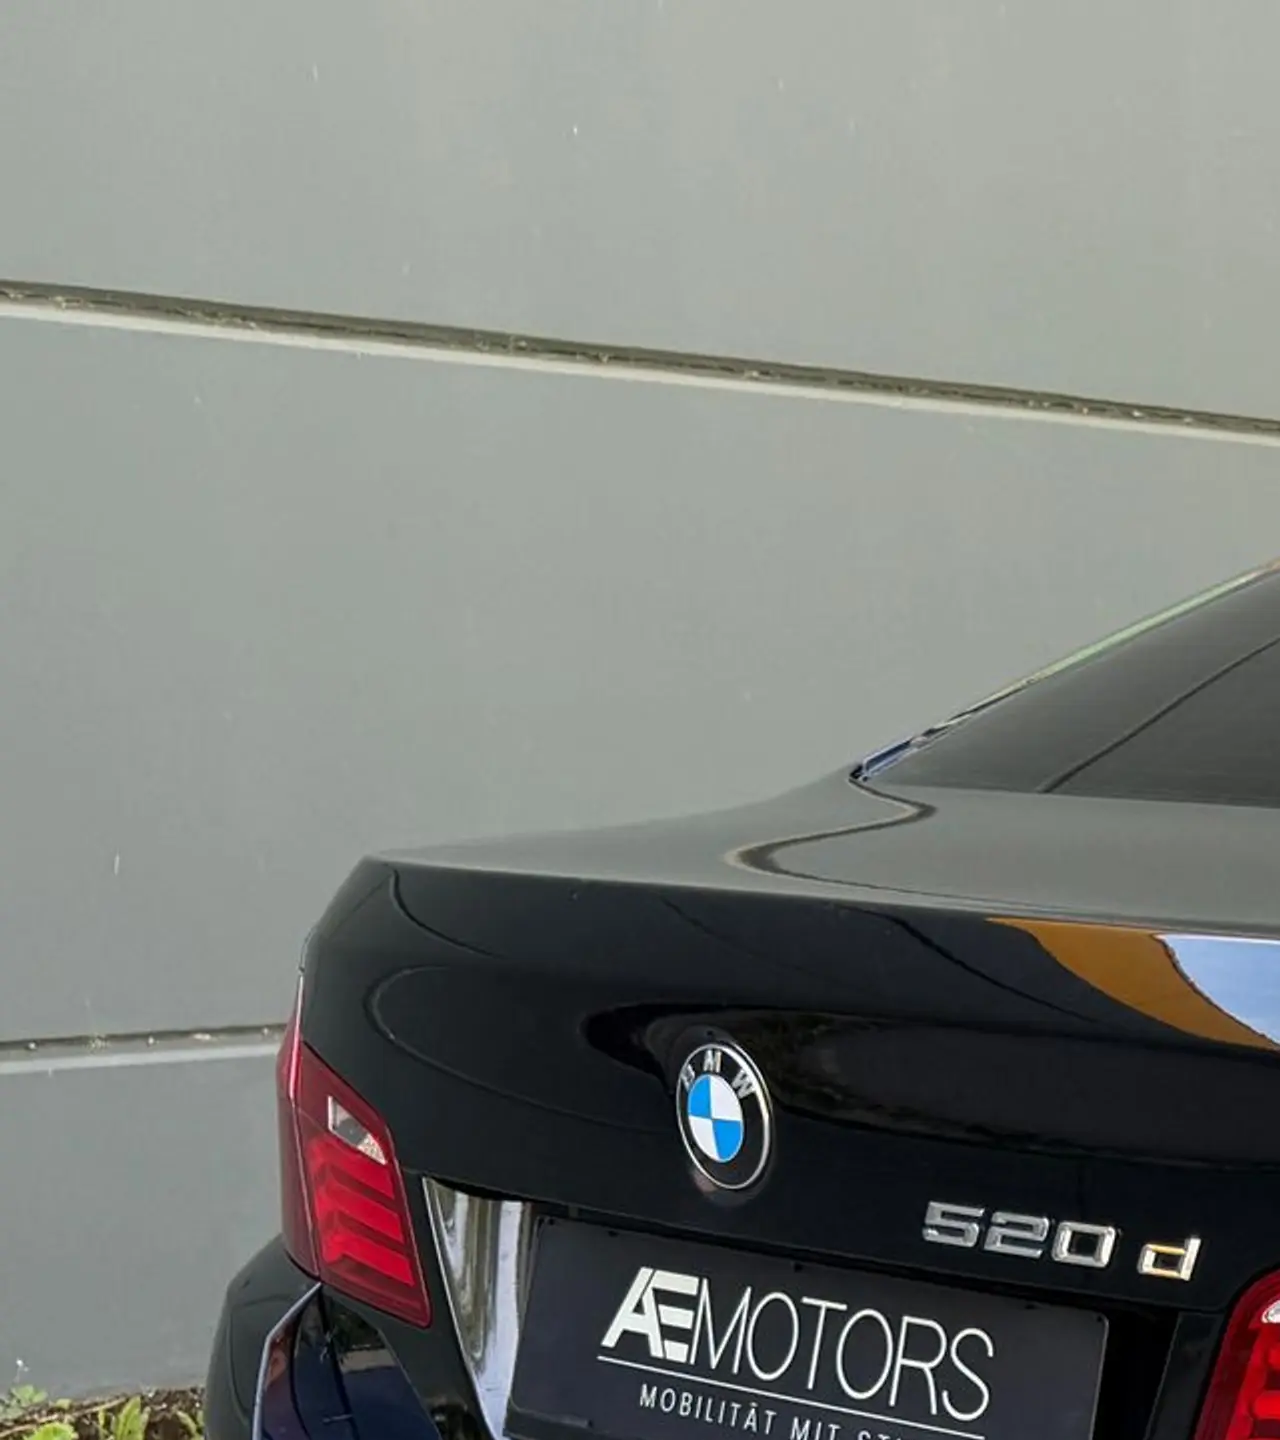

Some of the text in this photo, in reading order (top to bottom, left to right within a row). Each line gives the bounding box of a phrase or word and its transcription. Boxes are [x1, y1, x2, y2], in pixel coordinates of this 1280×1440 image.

[681, 1049, 756, 1099] BMW
[922, 1201, 1201, 1281] 520 d
[639, 1383, 777, 1435] MOBILITÄT
